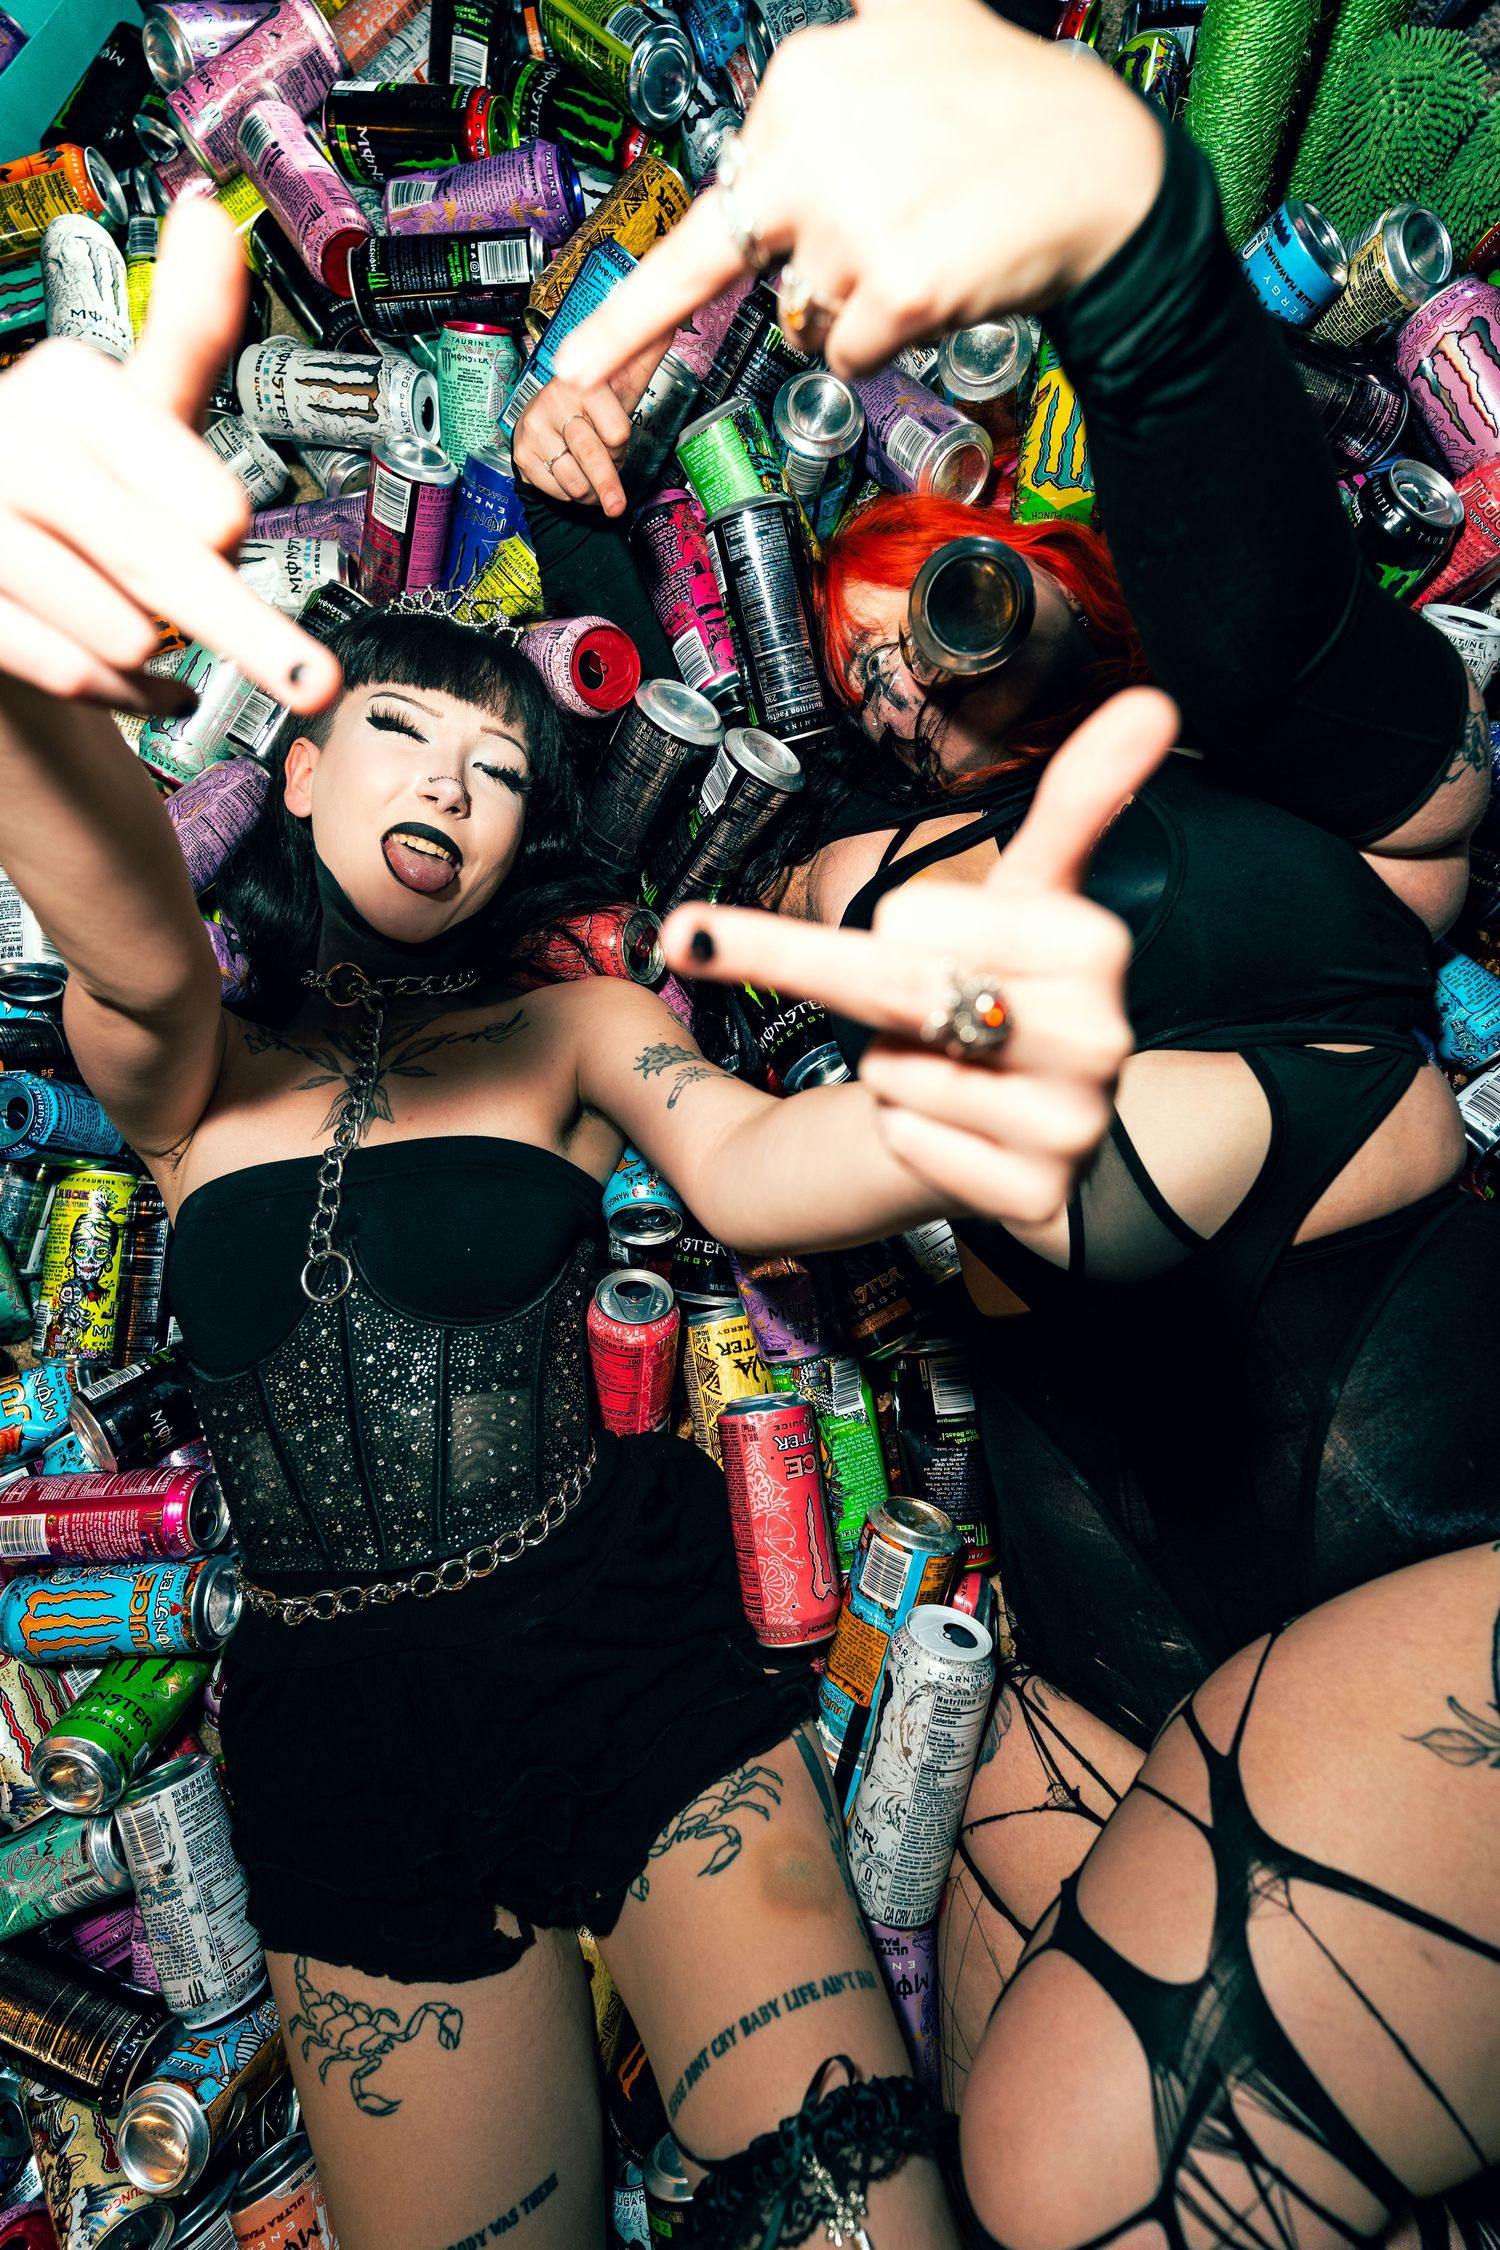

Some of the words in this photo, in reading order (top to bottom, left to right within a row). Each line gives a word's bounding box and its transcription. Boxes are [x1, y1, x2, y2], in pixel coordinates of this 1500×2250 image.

[450, 336, 492, 348] TAURINE
[936, 1694, 977, 1708] Nutrition
[931, 1715, 957, 1726] Calories
[883, 1905, 895, 1924] CA
[894, 1907, 911, 1926] CRV
[783, 1981, 822, 2012] LIFE
